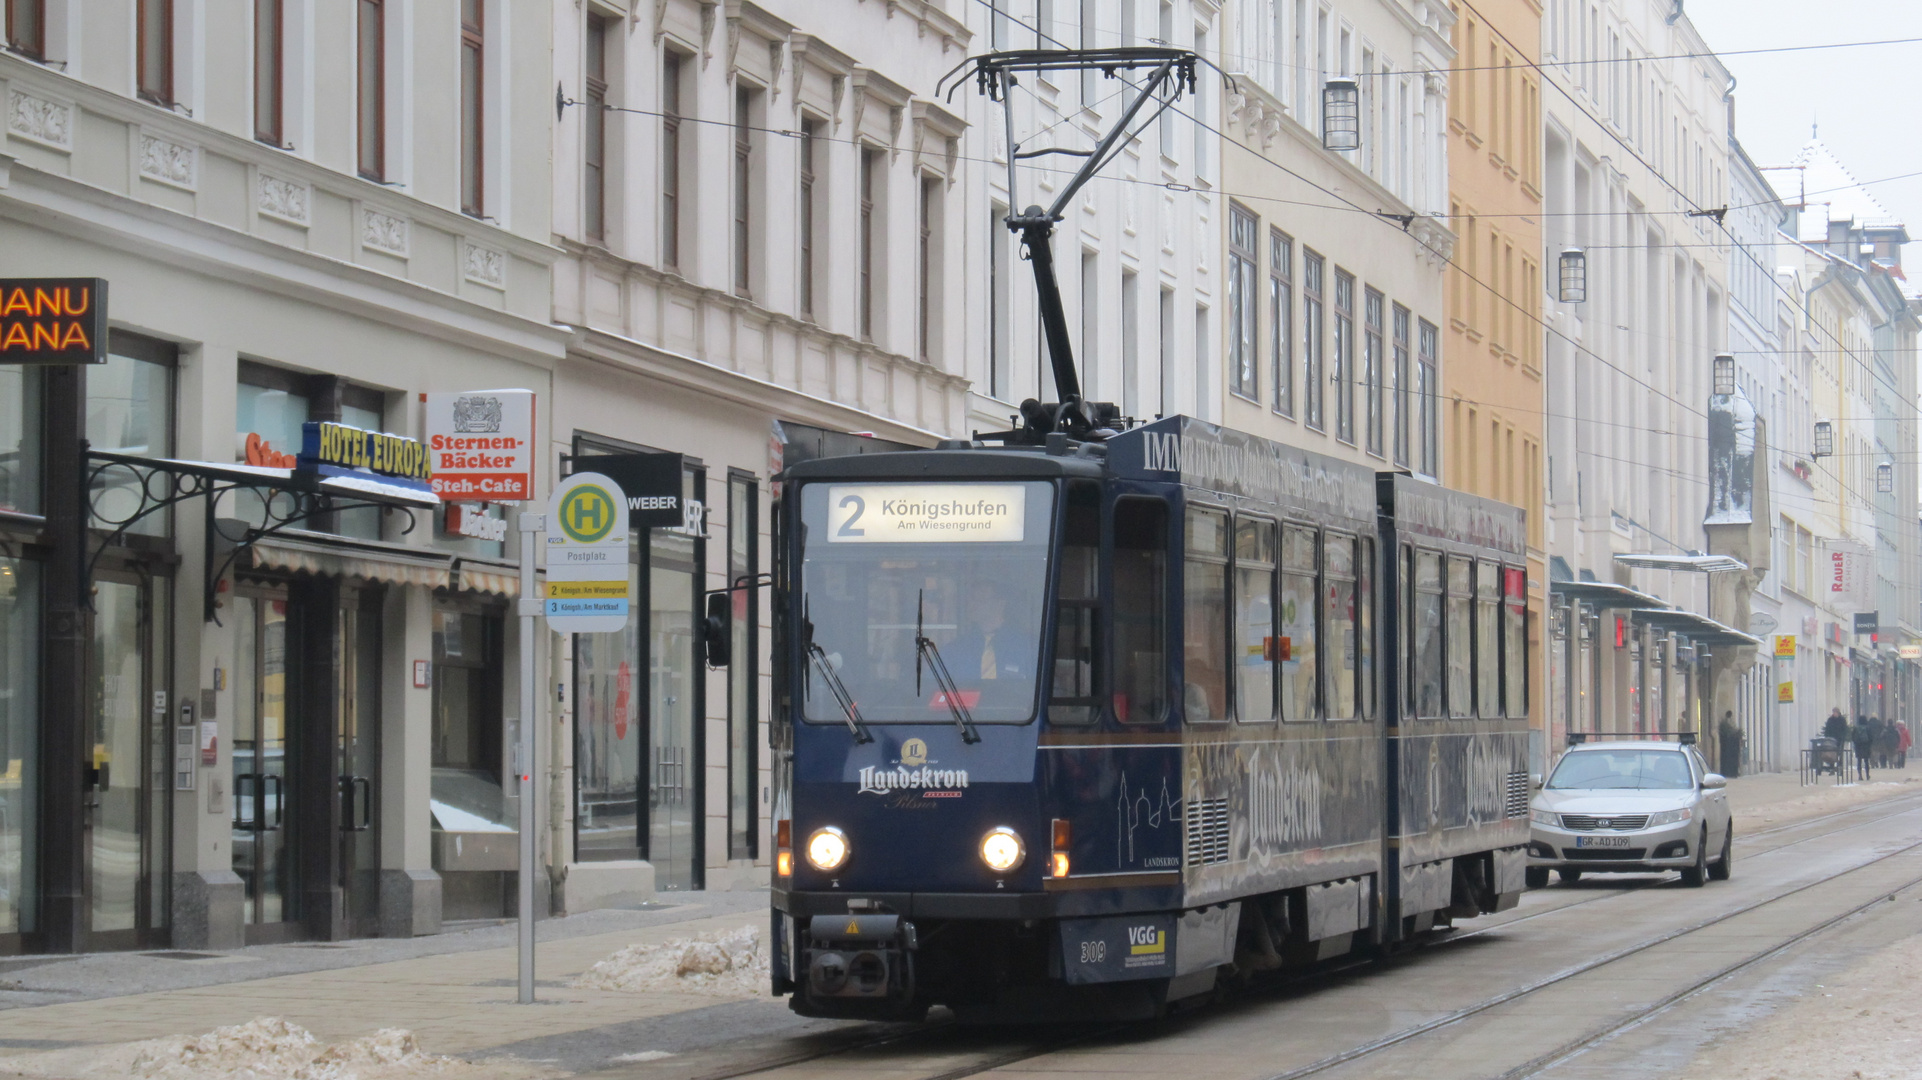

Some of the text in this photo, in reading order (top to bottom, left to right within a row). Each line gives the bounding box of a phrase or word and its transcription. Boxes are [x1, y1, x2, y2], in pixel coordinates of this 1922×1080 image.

[0, 287, 89, 317] ANU
[0, 321, 91, 351] ANA
[319, 422, 432, 478] HOTEL EUROPA
[431, 434, 524, 450] Sternen-
[440, 452, 516, 469] Bäcker
[1143, 431, 1195, 476] IMMER
[432, 479, 522, 493] Steh-Cafe
[628, 496, 677, 510] WEBER
[574, 498, 601, 529] H
[837, 495, 1008, 537] 2 Königshufen
[897, 520, 992, 532] Am Wiesengrund
[568, 551, 607, 562] Postplatz
[1831, 552, 1843, 593] RAUER
[551, 586, 557, 595] 2
[594, 585, 627, 596] Wiesengrund
[551, 602, 557, 612] 3
[857, 765, 969, 795] Landskron
[1612, 837, 1629, 847] 109
[1144, 857, 1179, 868] LANDSKRON
[1128, 925, 1156, 945] VGG
[1080, 940, 1106, 963] 309
